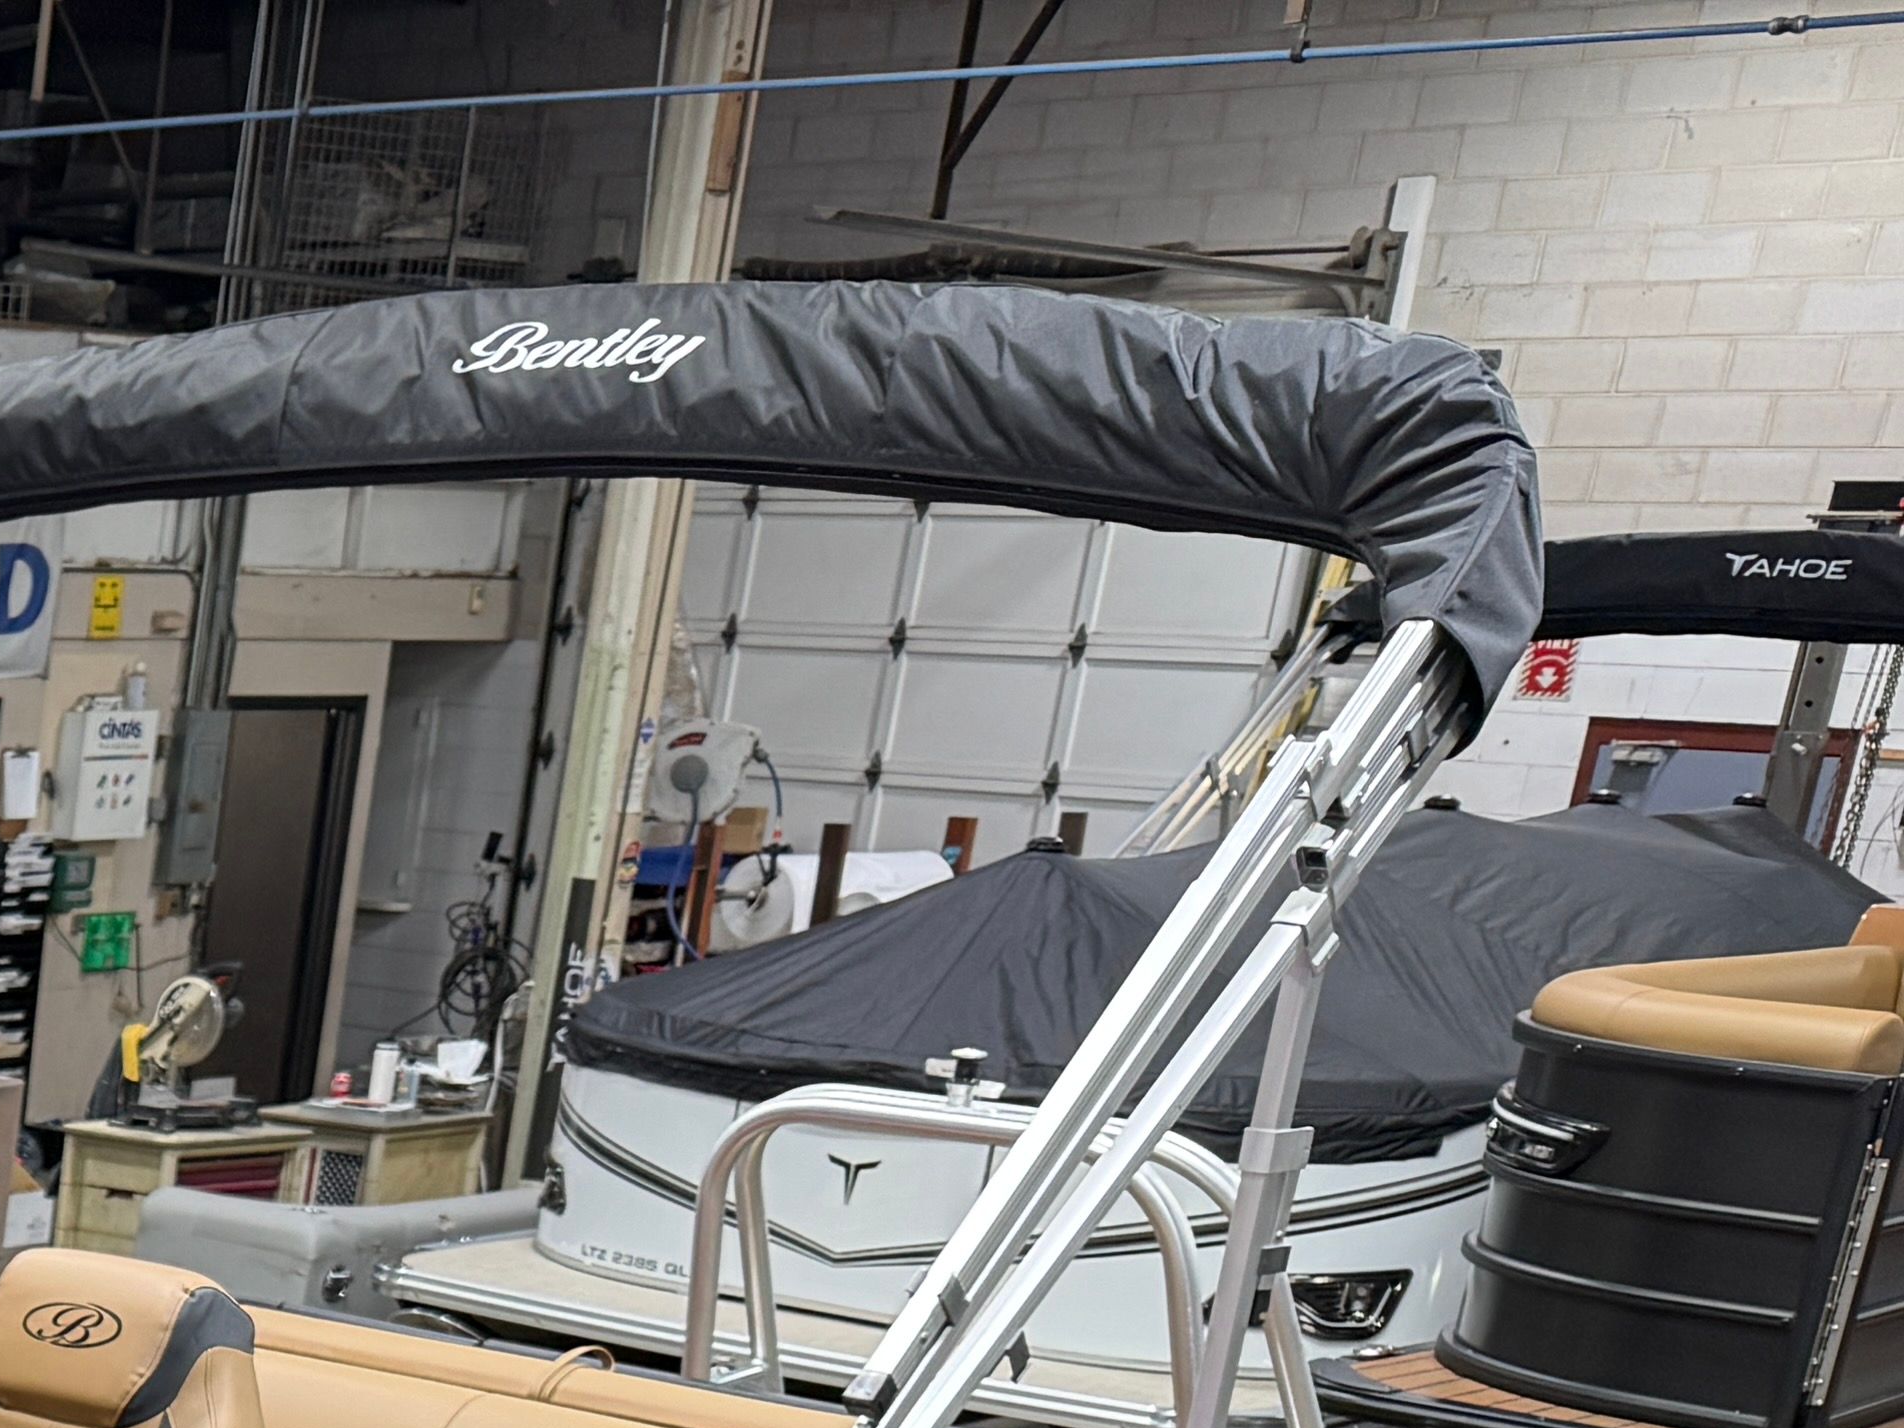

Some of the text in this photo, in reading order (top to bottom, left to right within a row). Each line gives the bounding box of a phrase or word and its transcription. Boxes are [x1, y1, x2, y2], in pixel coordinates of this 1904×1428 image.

[452, 317, 706, 383] Bentley
[1725, 552, 1853, 580] TAHOE
[581, 1243, 607, 1261] LTZ
